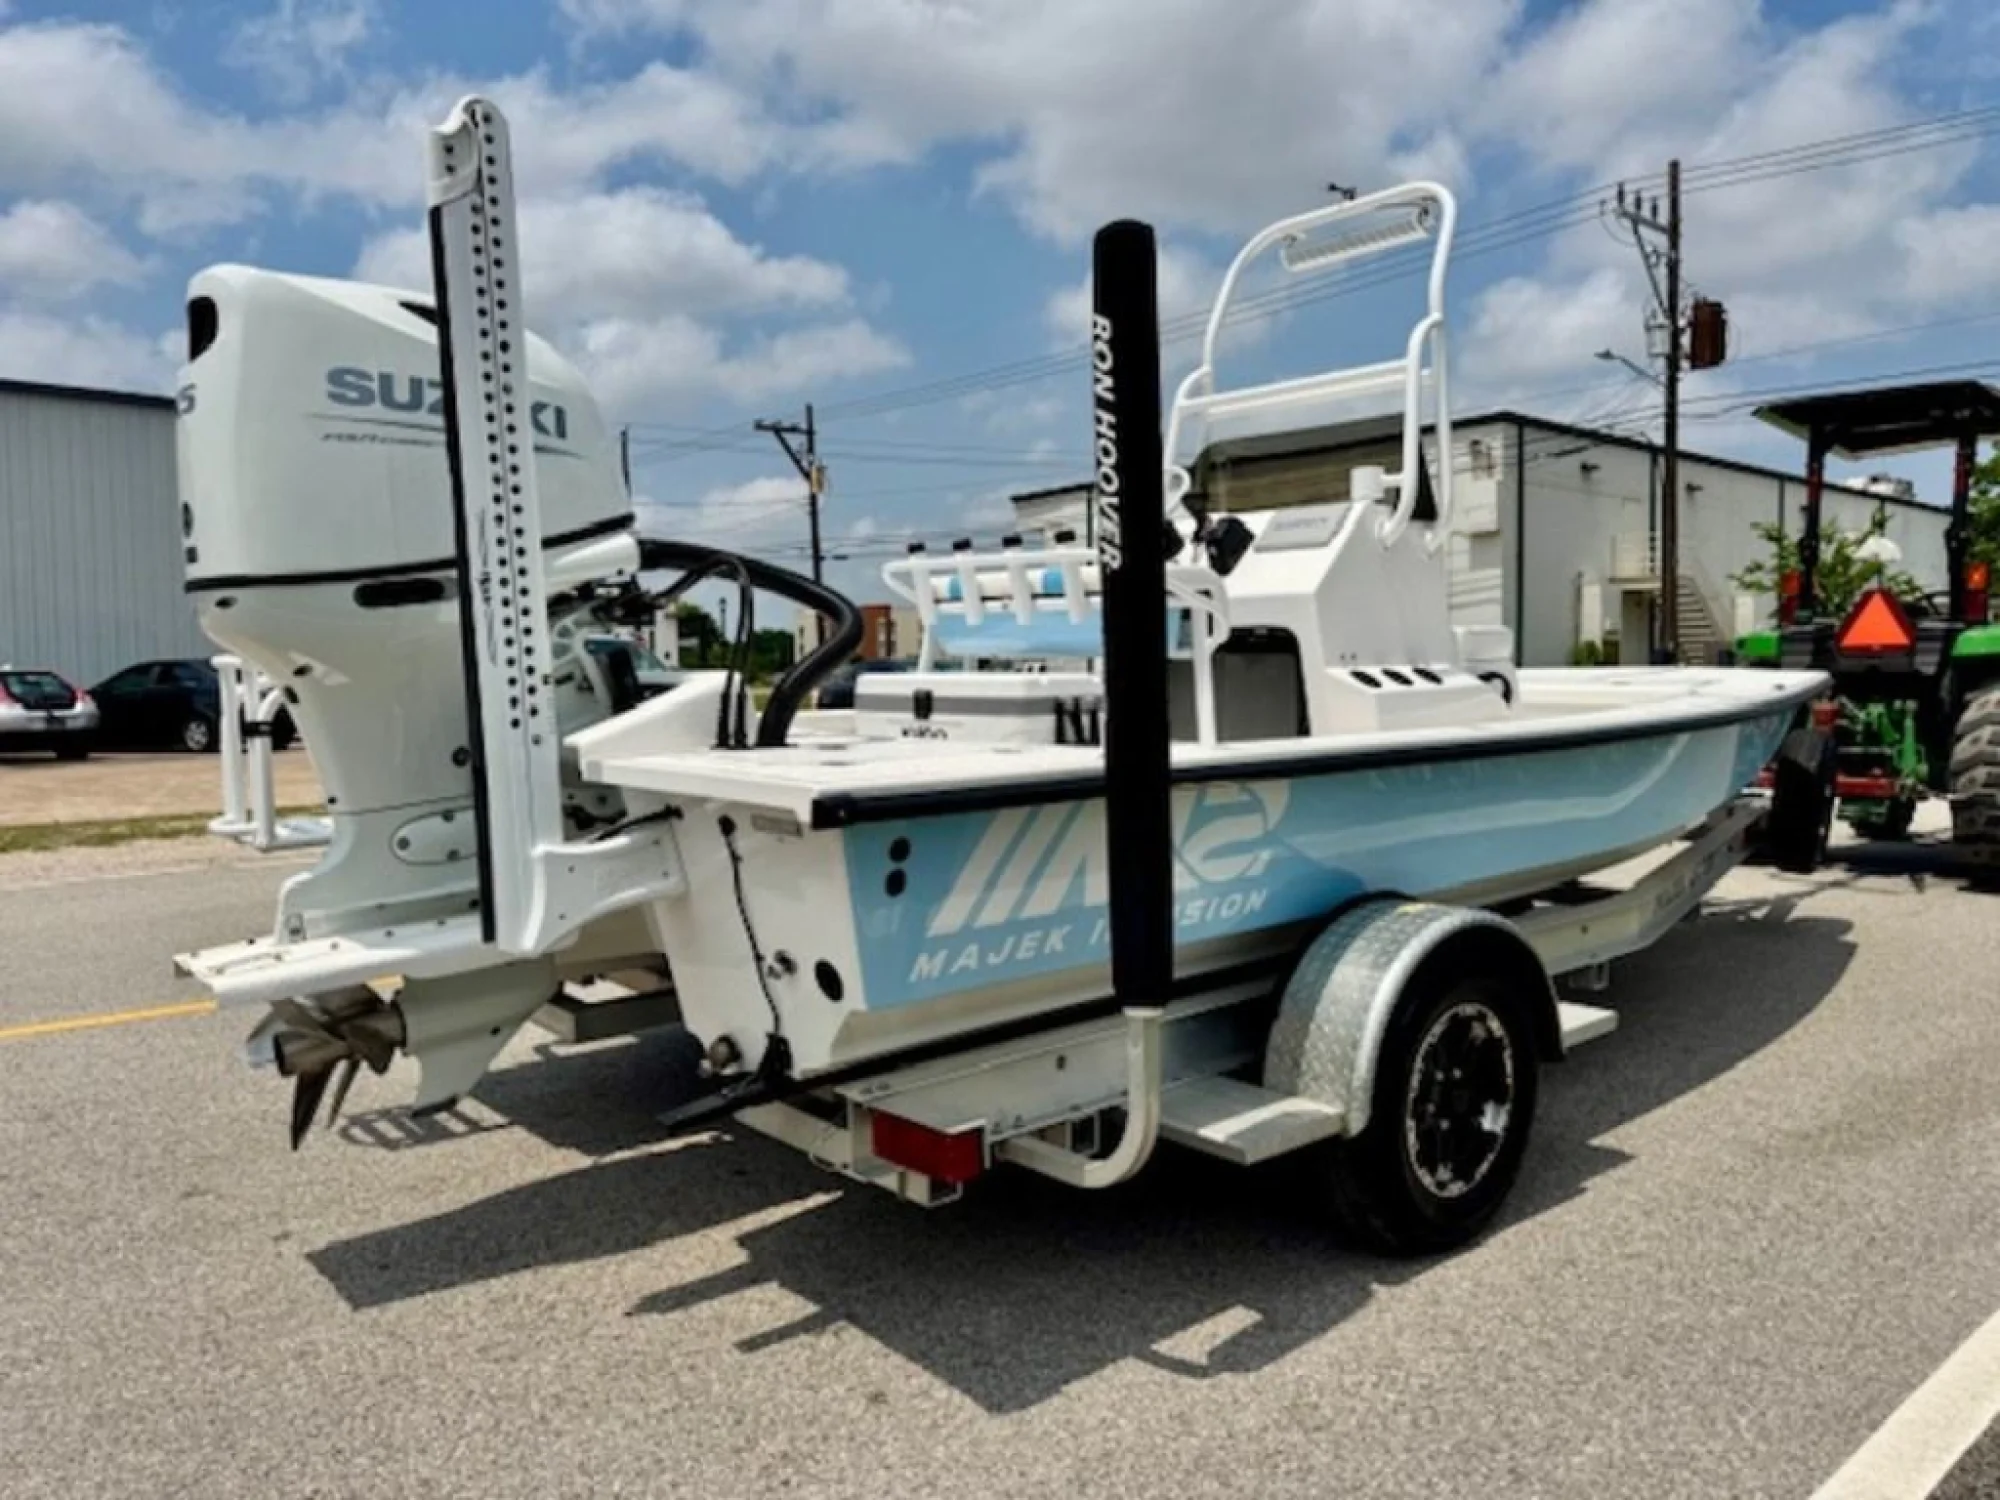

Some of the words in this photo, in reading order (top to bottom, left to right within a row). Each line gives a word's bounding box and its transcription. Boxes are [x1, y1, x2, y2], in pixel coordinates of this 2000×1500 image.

[1095, 409, 1121, 571] HOOVER
[909, 924, 1073, 983] MAJEK
[1089, 888, 1268, 946] ISION
